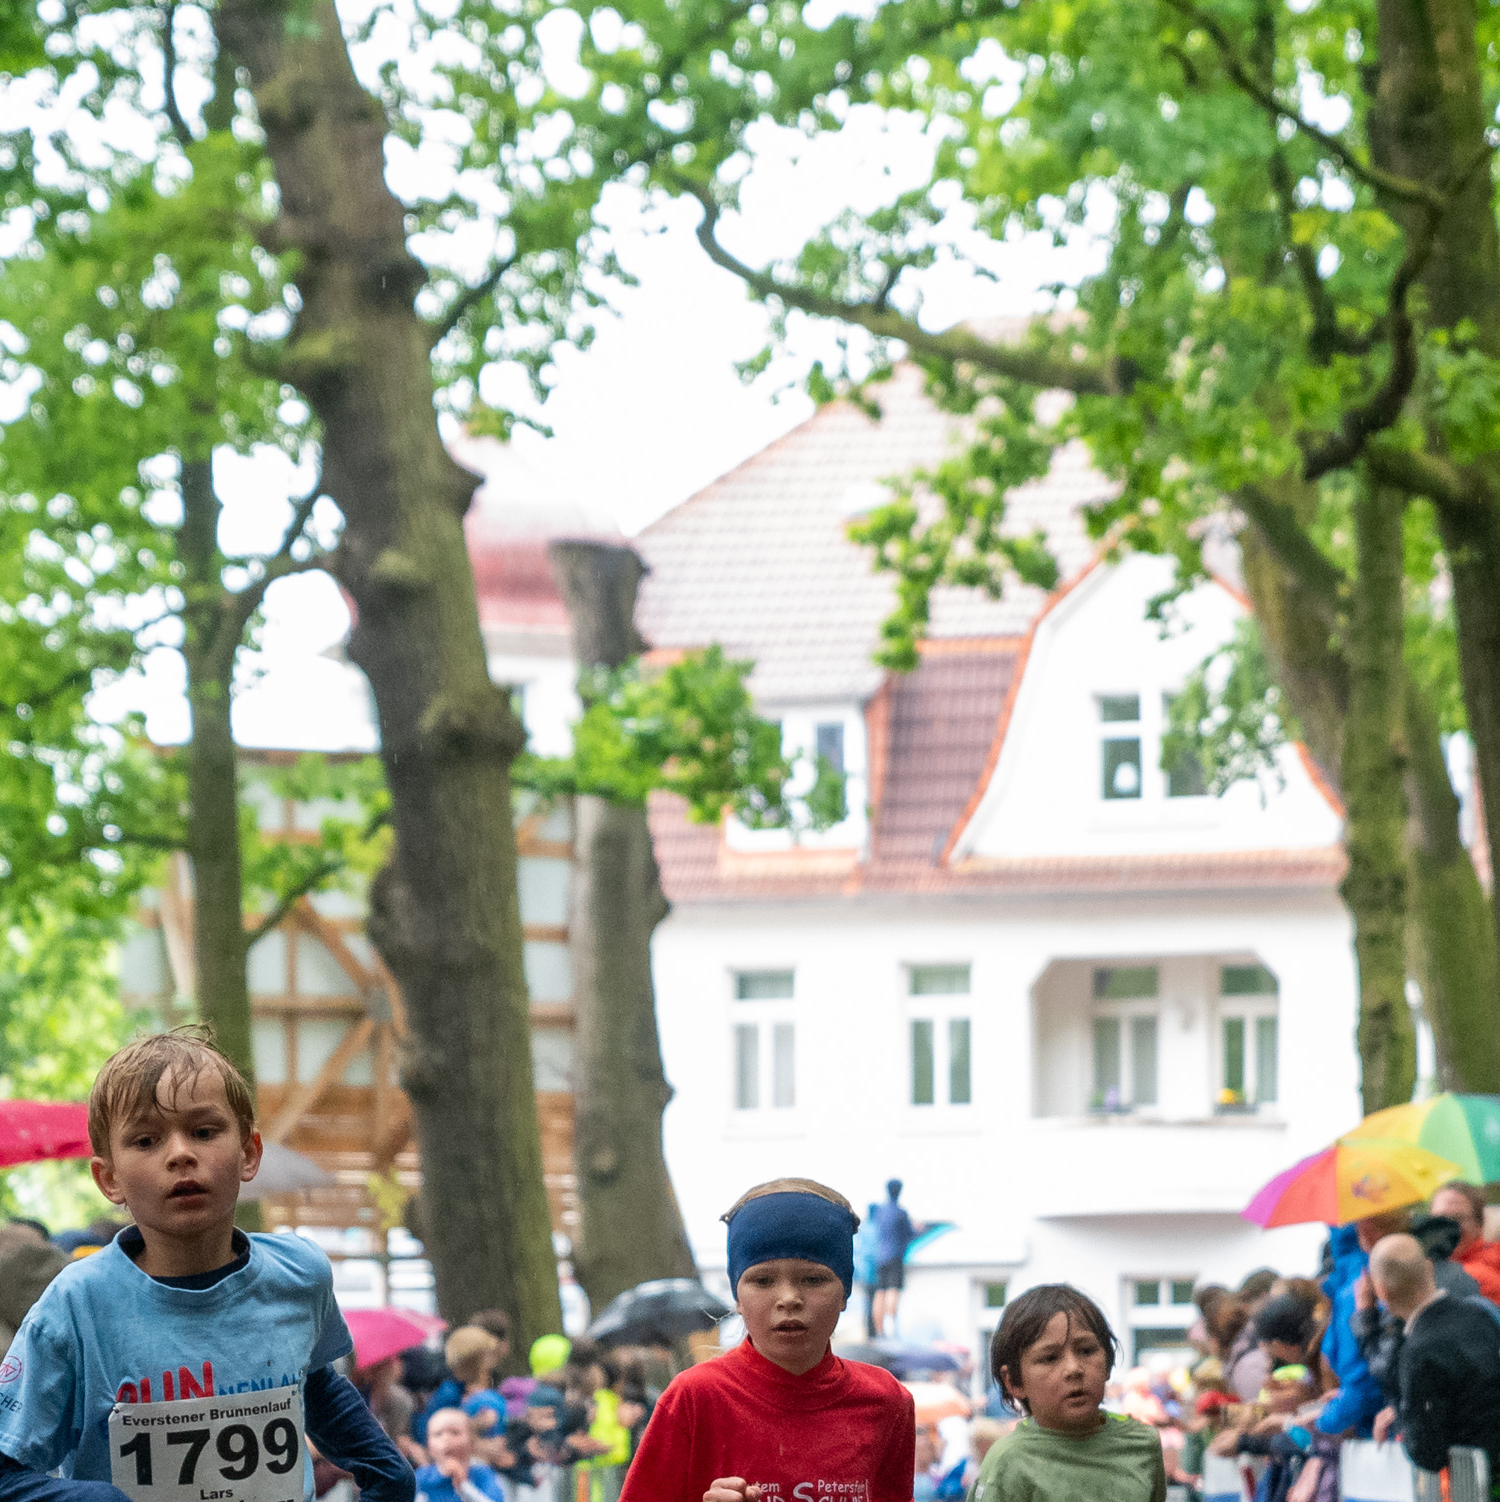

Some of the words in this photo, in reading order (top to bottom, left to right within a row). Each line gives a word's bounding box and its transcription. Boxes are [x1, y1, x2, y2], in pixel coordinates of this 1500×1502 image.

[122, 1412, 205, 1427] Everstener
[209, 1398, 292, 1421] Brunnenlauf
[119, 1417, 299, 1486] 1799
[200, 1488, 234, 1501] Lars
